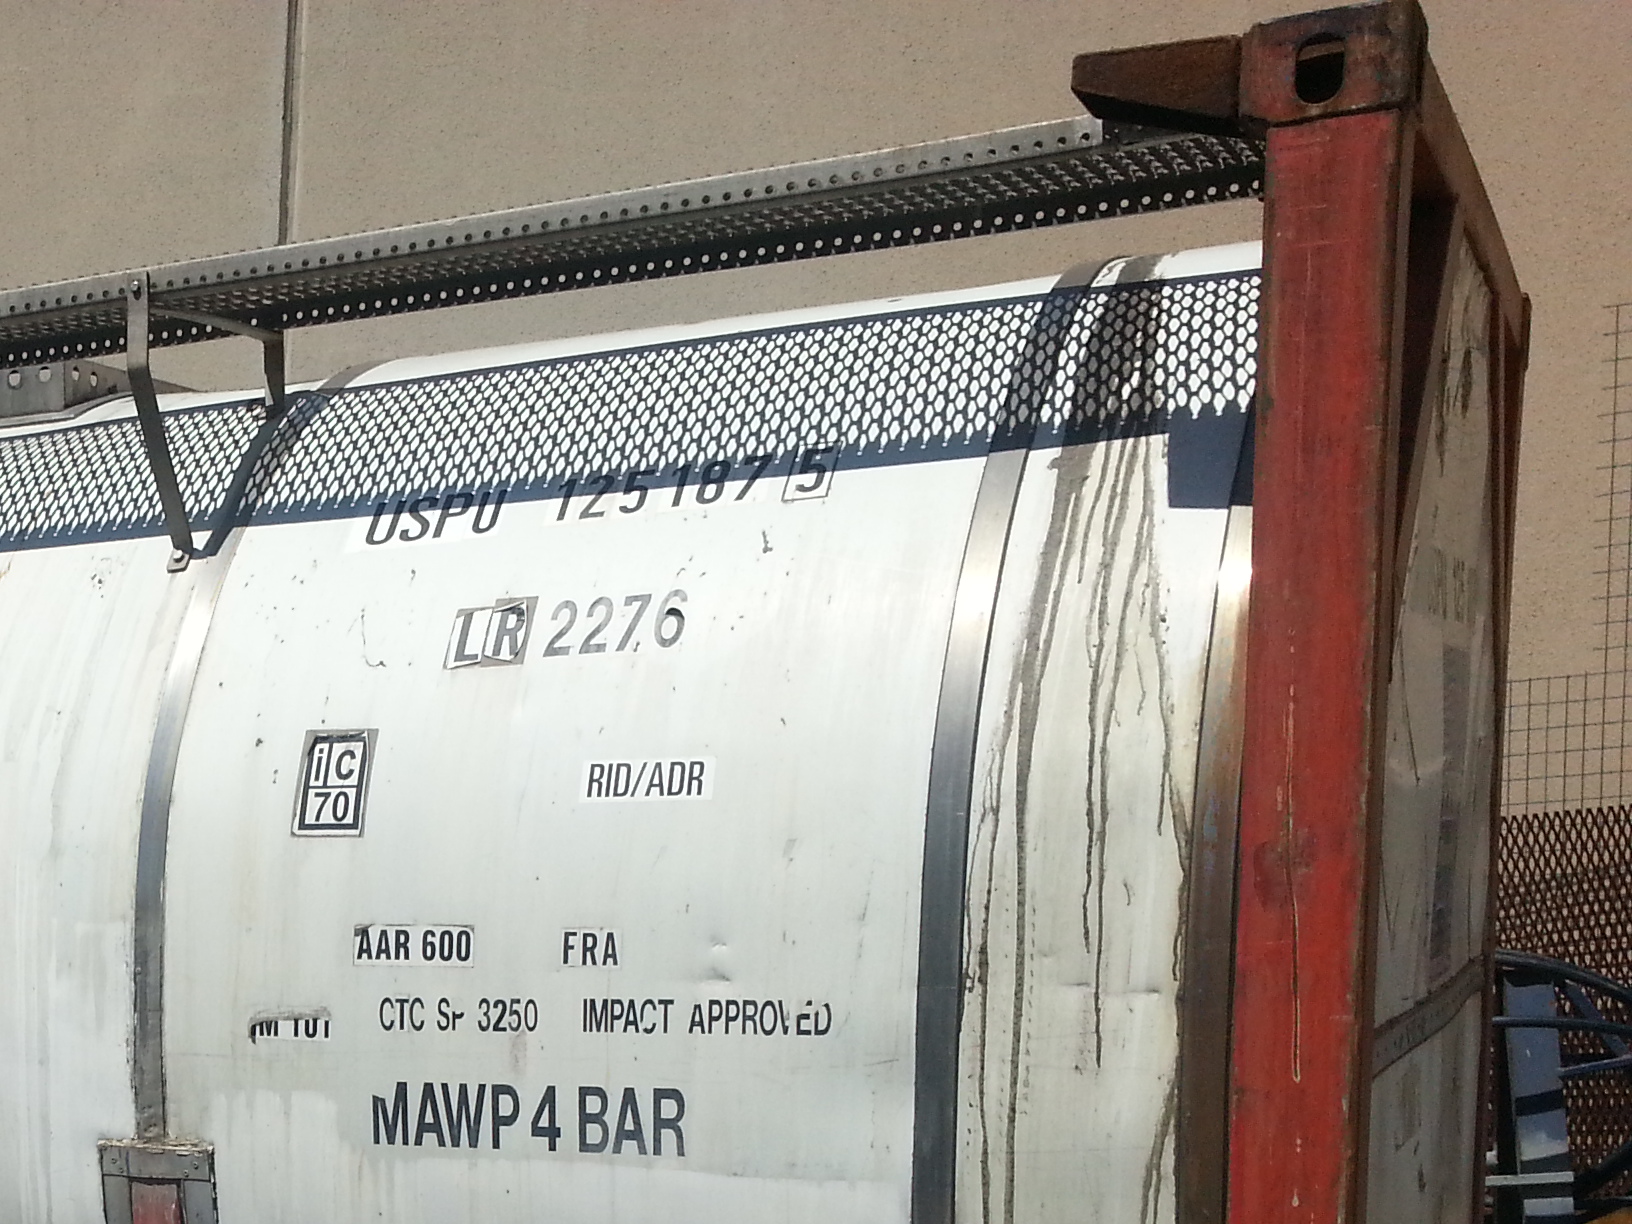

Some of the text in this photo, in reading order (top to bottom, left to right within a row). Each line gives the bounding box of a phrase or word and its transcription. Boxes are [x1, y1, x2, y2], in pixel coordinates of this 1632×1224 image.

[365, 445, 834, 546] USPU 125 187 5
[542, 588, 689, 659] 2276
[586, 760, 706, 799] RID/ADR
[313, 791, 350, 823] 70
[356, 929, 472, 963] AAR 600
[562, 931, 620, 967] FRA
[379, 997, 425, 1031] CTC
[477, 997, 539, 1032] 3250
[582, 998, 675, 1034] IMPACT
[372, 1080, 687, 1157] MAWP 4 BAR
